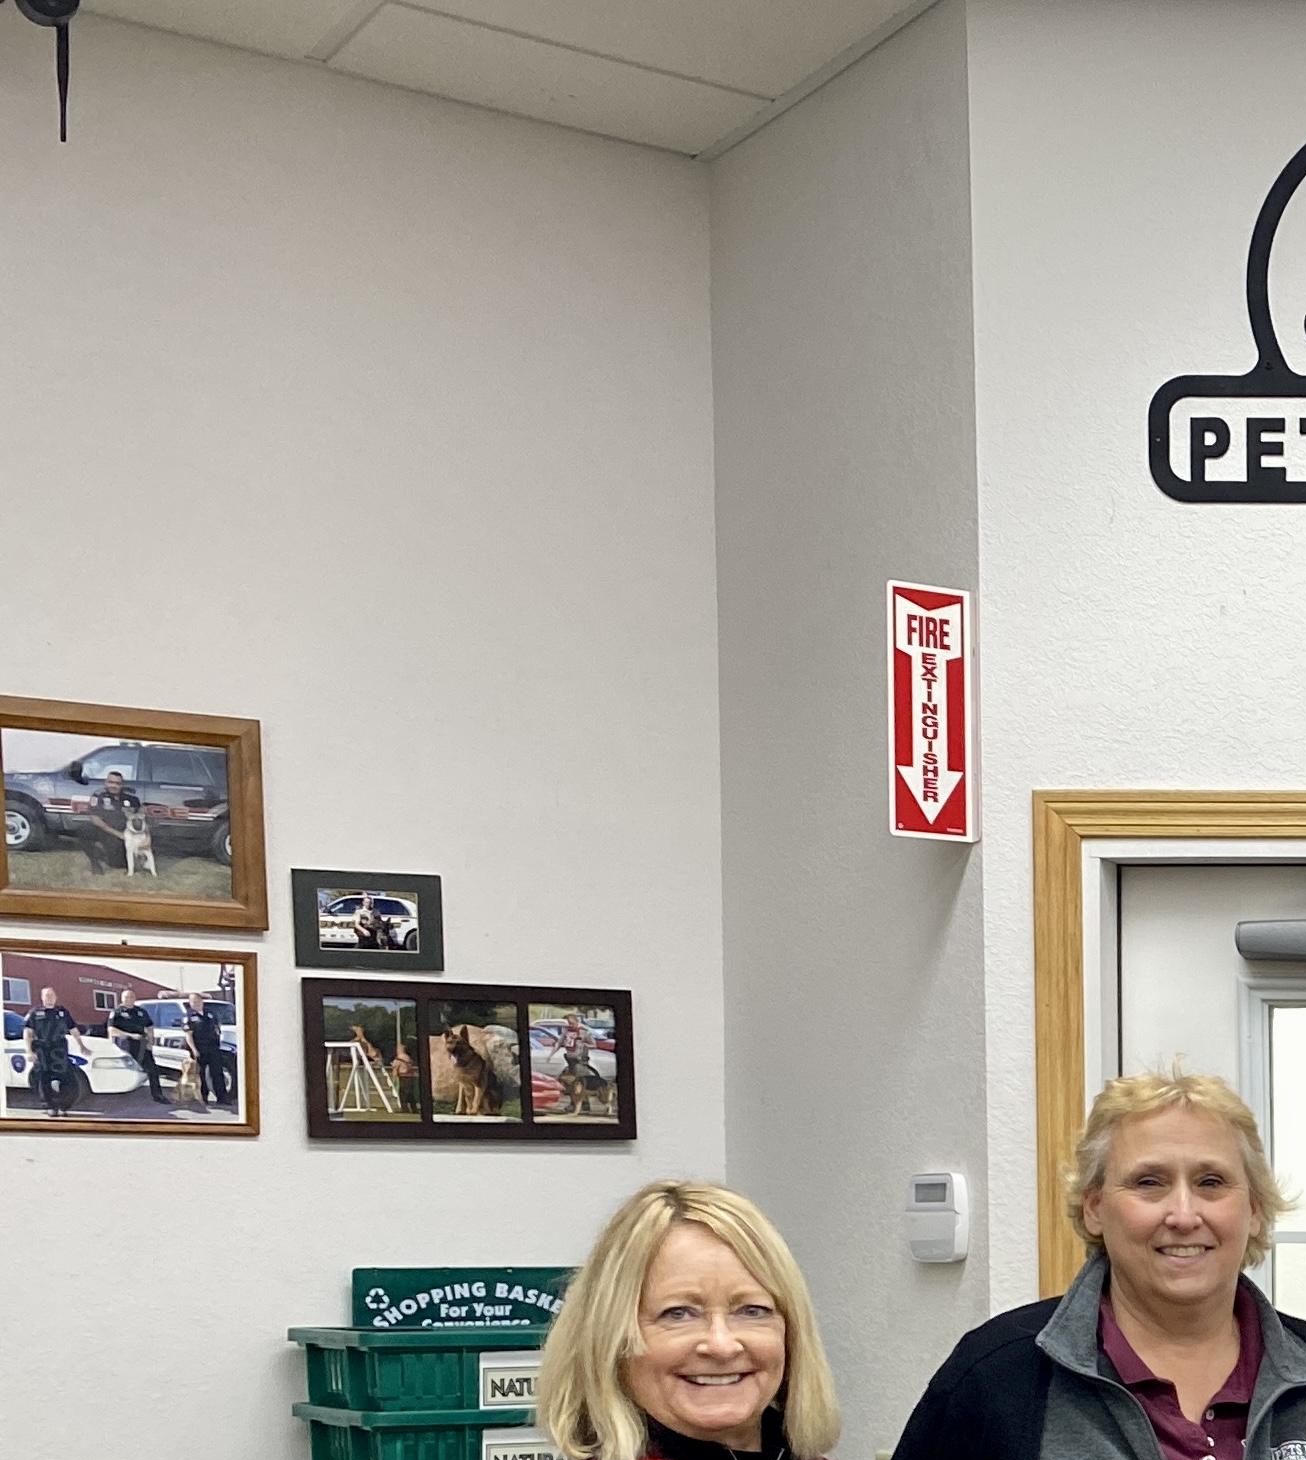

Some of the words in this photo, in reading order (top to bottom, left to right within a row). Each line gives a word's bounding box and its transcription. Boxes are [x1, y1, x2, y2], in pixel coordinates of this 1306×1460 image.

[906, 613, 951, 651] FIRE
[921, 651, 939, 804] EXTINGUISHER
[372, 1281, 487, 1328] SHOPPING
[440, 1304, 468, 1318] For
[473, 1303, 513, 1318] Your
